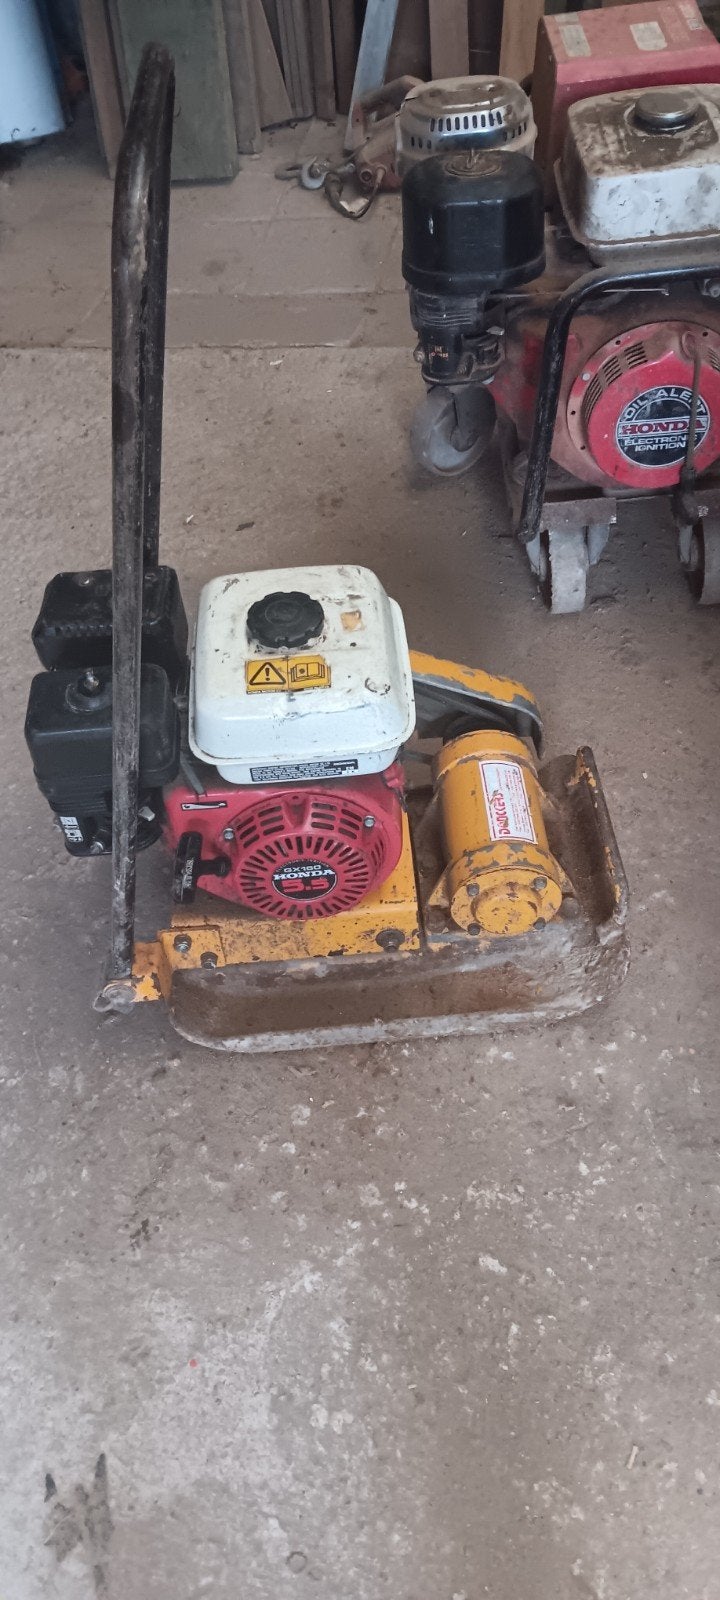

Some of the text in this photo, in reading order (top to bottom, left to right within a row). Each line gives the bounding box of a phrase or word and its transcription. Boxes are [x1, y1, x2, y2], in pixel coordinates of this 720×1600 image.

[623, 388, 707, 420] OIL ALET
[624, 434, 698, 446] ELECTRON
[634, 441, 687, 452] IGNITION
[283, 864, 322, 873] GX160
[273, 869, 336, 881] HONDA
[281, 877, 330, 893] 5.5
